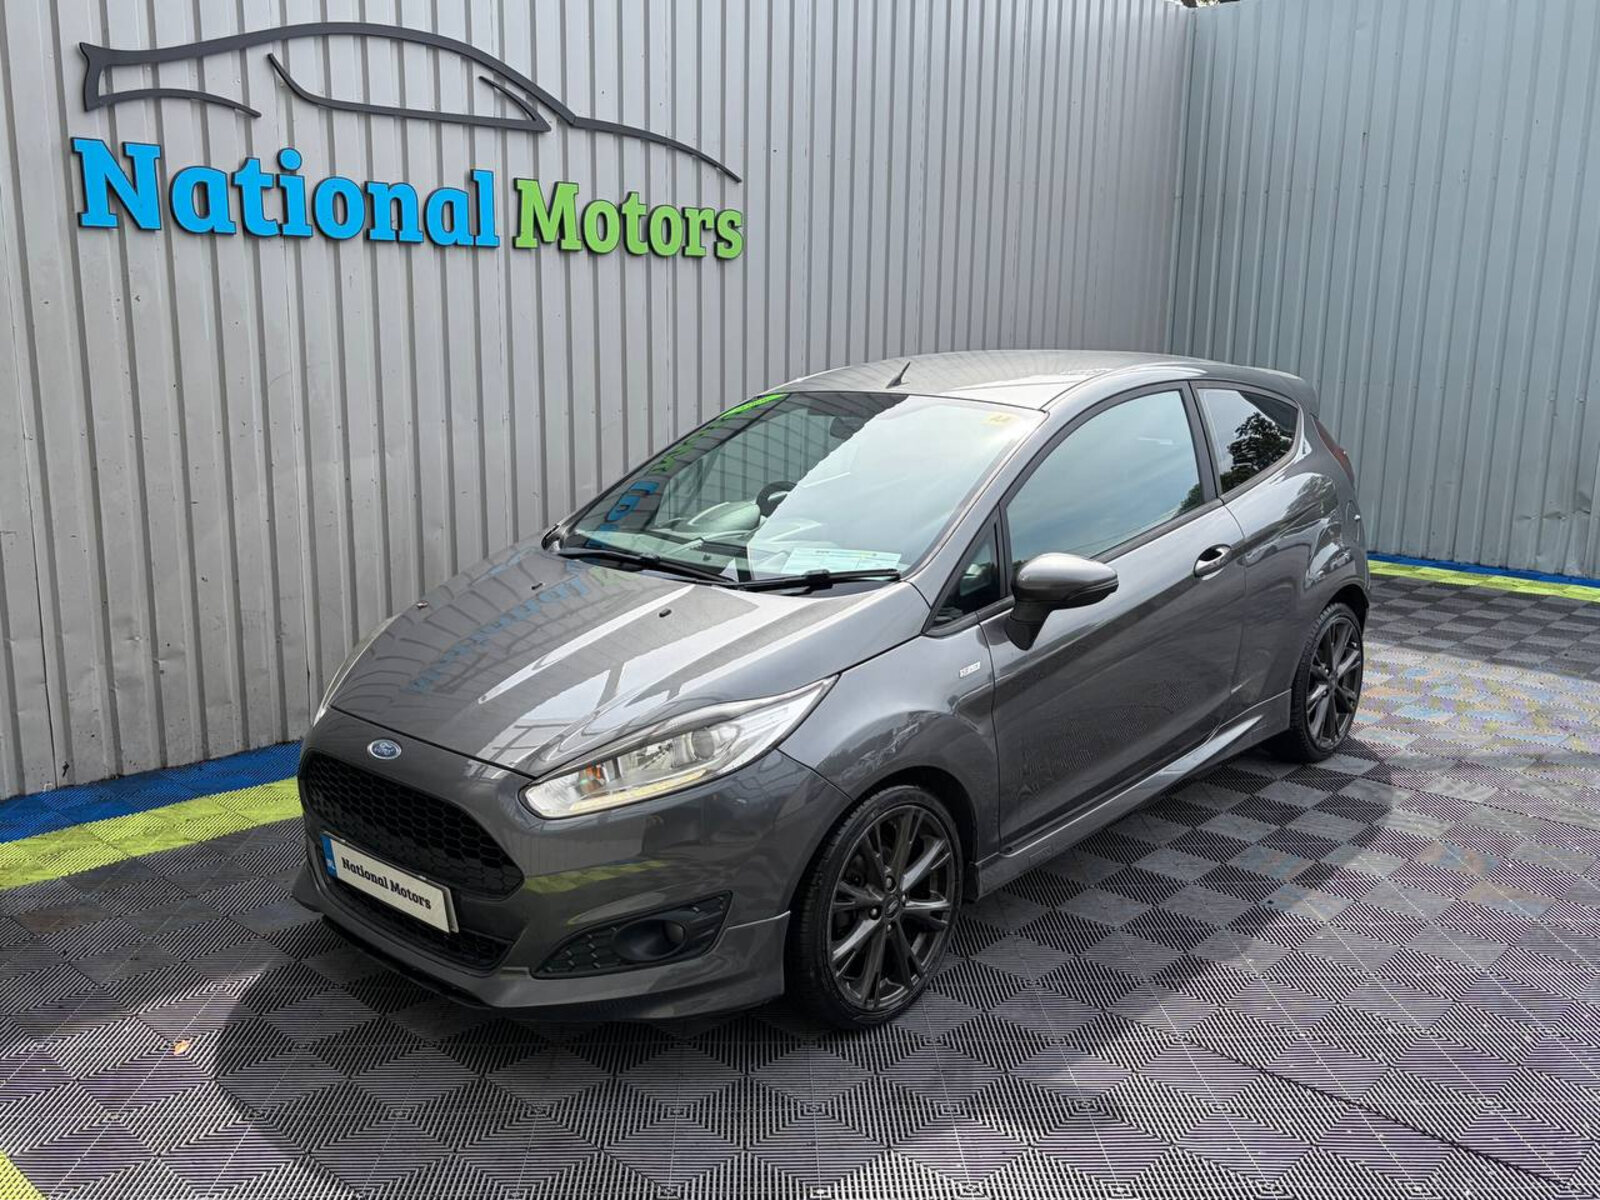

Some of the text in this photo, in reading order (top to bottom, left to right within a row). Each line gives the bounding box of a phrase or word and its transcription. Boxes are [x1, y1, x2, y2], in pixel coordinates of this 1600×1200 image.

[70, 137, 744, 259] National Motors
[341, 857, 432, 910] National Motors
